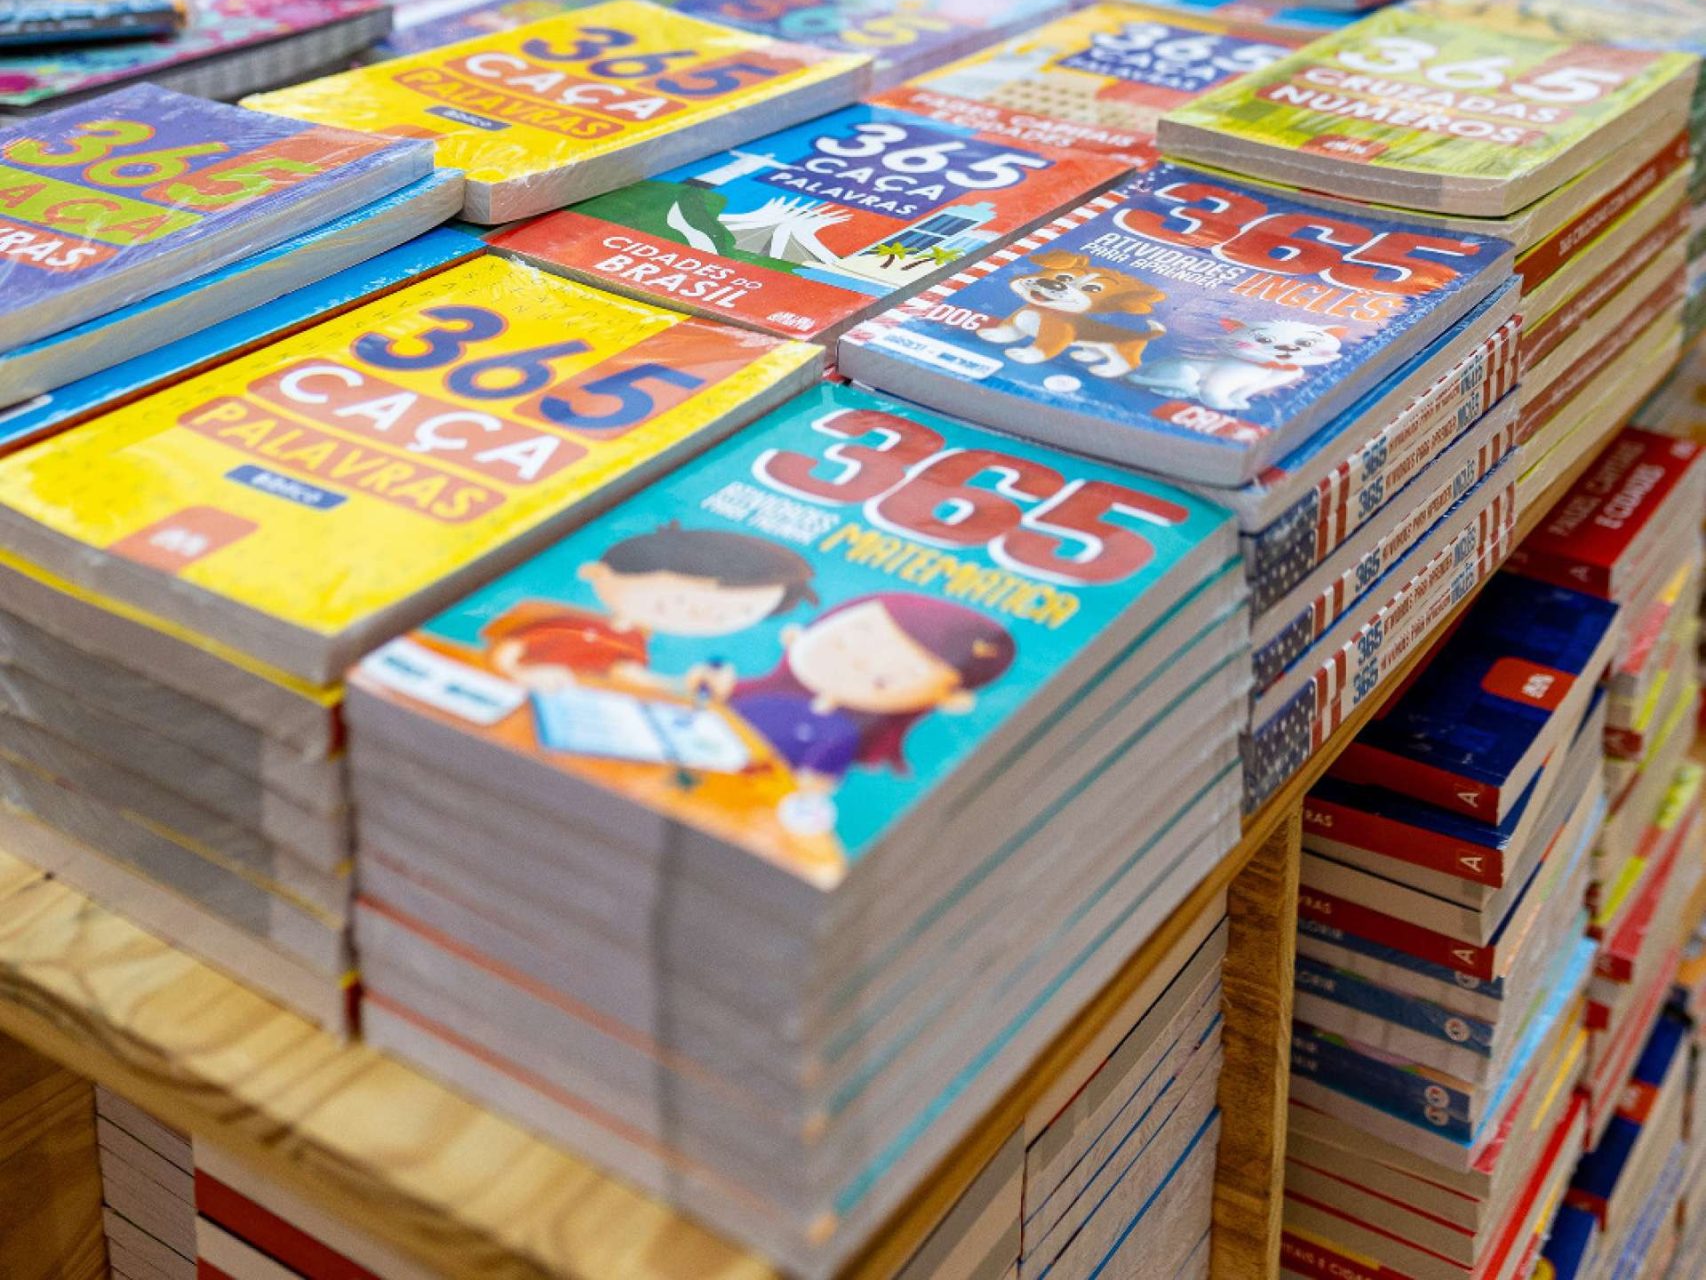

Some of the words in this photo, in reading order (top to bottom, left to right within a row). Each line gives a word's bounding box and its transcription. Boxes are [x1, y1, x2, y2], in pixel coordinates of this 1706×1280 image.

[520, 26, 780, 96] 365
[1091, 22, 1294, 72] 365
[1337, 36, 1627, 104] 365
[401, 69, 611, 138] PALAVRAS
[465, 52, 674, 120] CAÇA
[1304, 67, 1561, 122] CRUZADAS
[2, 120, 323, 208] 365
[804, 157, 945, 201] CAÇA
[815, 123, 1048, 189] 365
[0, 182, 173, 245] AÇA
[769, 172, 918, 215] PALAVRAS
[0, 227, 97, 267] RAS
[602, 236, 736, 280] CIDADES
[730, 278, 763, 290] DO
[1079, 240, 1131, 265] PARA
[1130, 256, 1225, 291] APRENDER
[1095, 232, 1247, 282] ATIVIDADES
[1113, 181, 1480, 296] 365
[595, 254, 748, 308] BRASIL
[924, 303, 991, 331] DOG
[350, 304, 707, 431] 365
[278, 365, 562, 481] CAÇA
[190, 401, 489, 519] PALAVRAS
[750, 408, 1190, 587] 365
